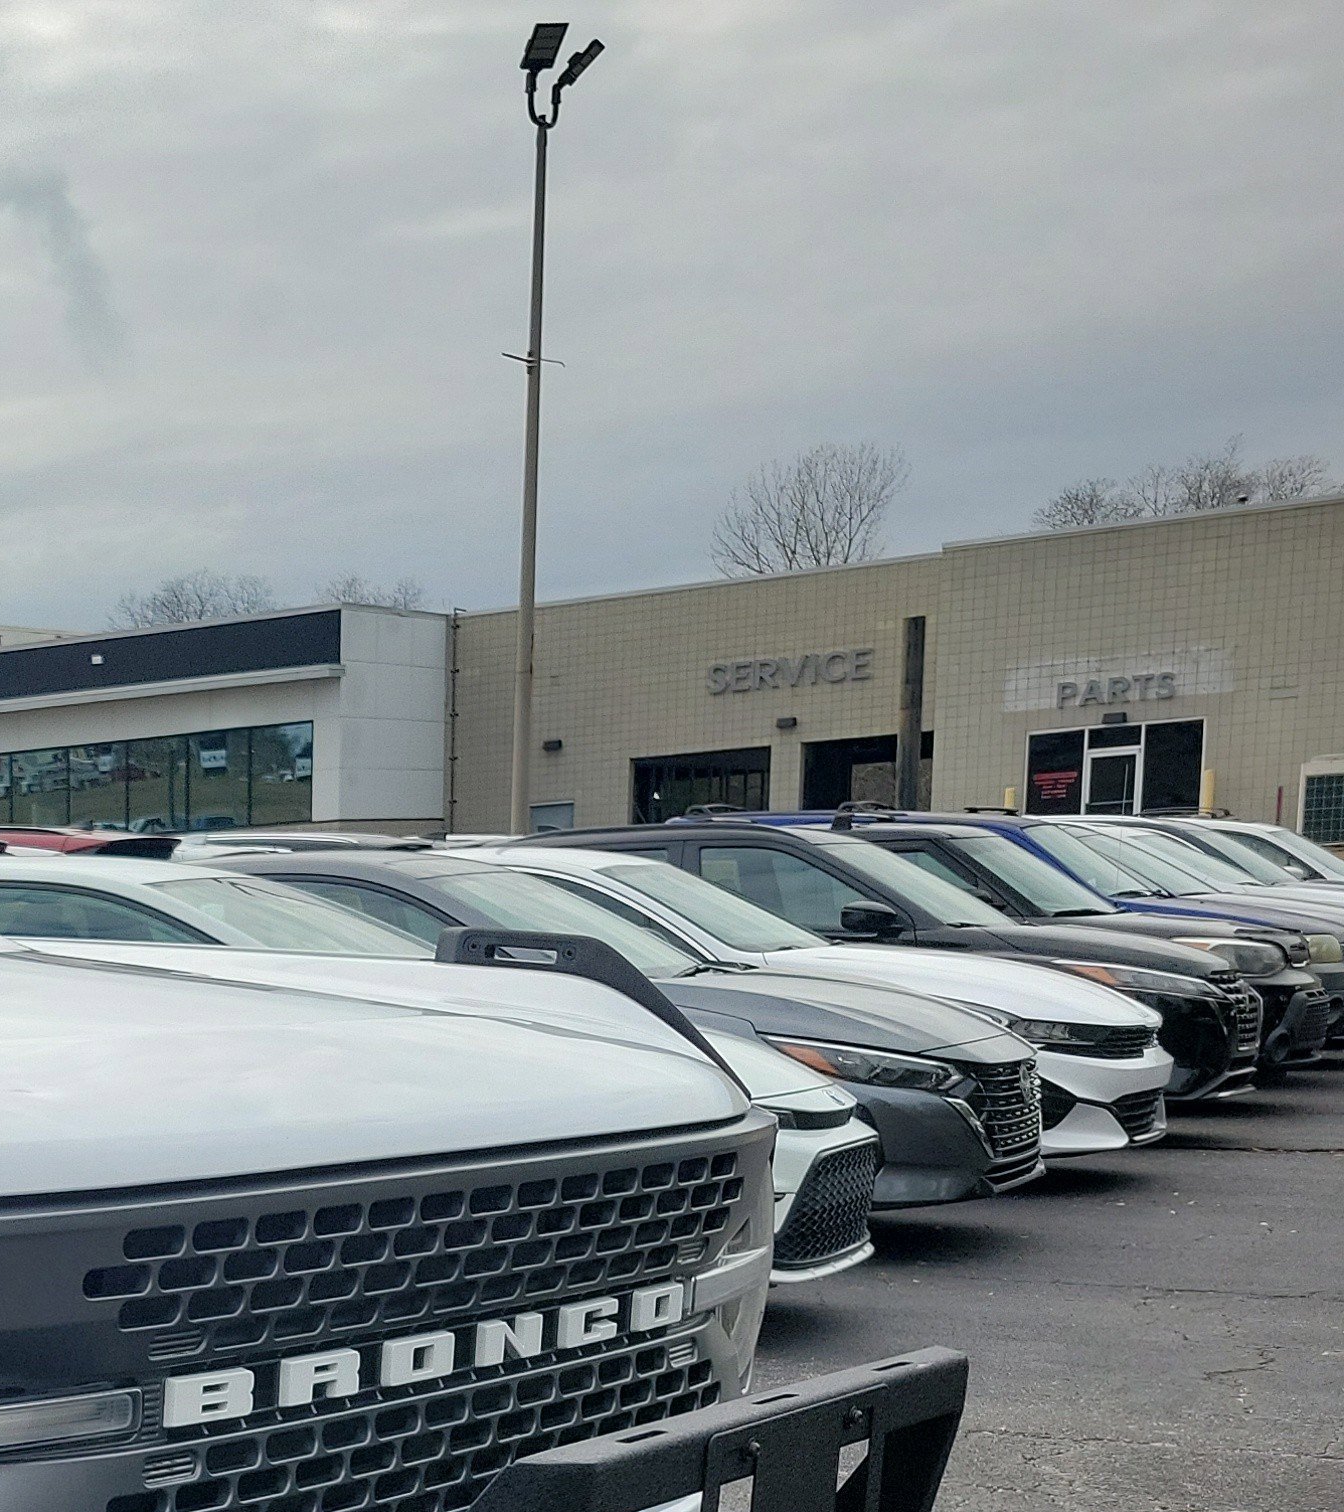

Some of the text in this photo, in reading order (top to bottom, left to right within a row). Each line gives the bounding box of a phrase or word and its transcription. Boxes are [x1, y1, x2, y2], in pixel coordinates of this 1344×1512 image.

[707, 647, 875, 695] SERVICE
[1055, 671, 1177, 709] PARTS
[163, 1282, 684, 1428] BRONCO
